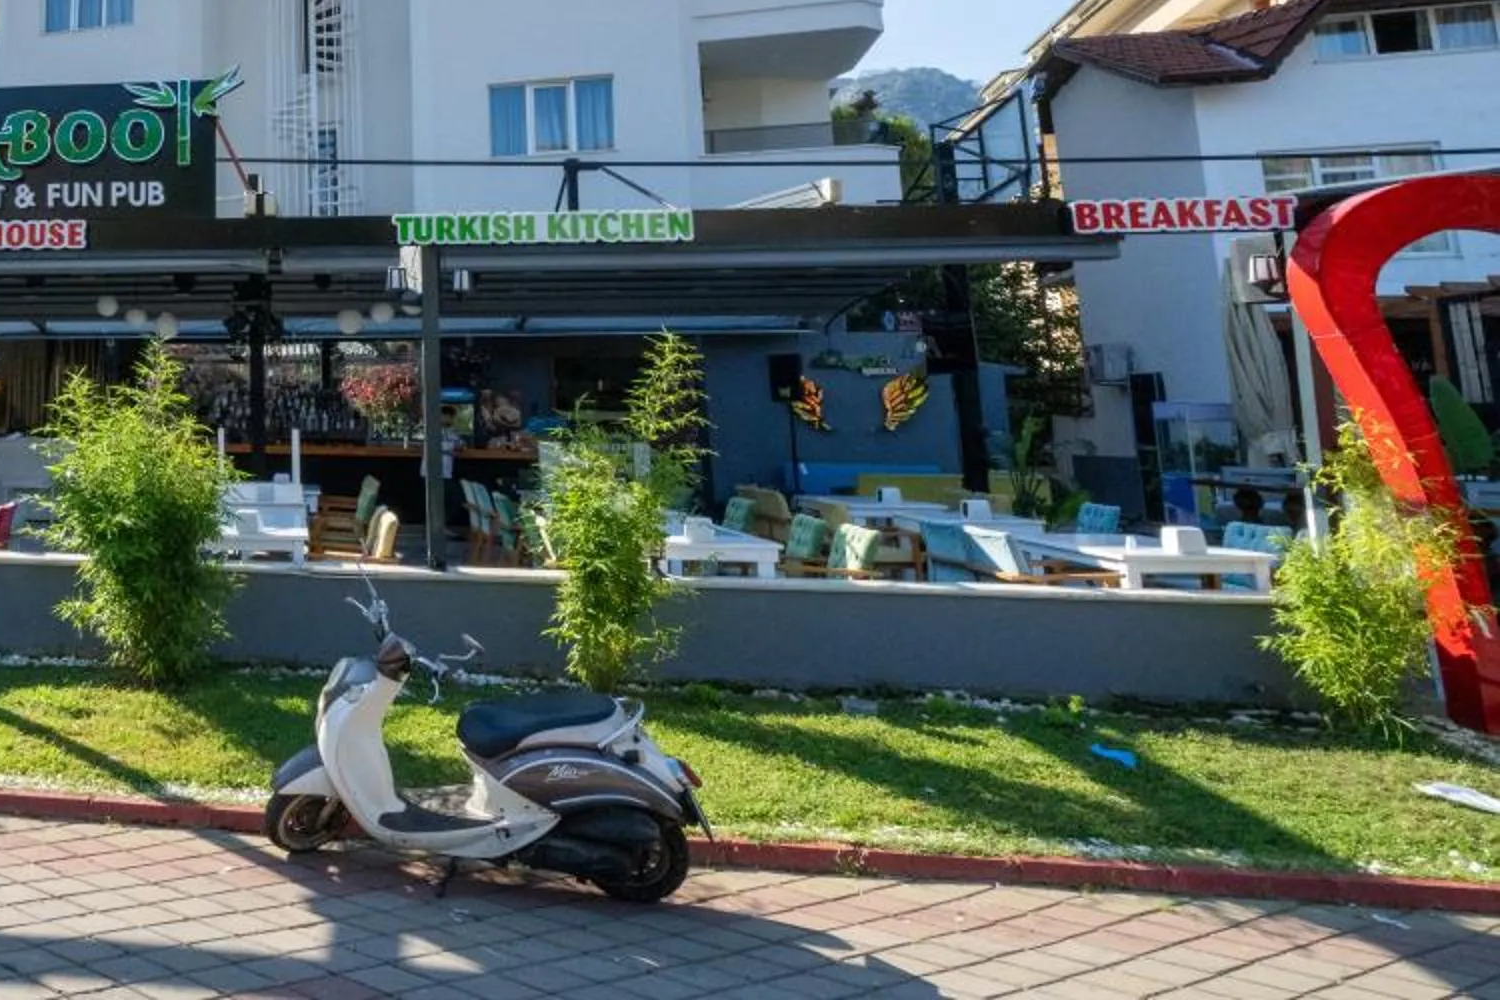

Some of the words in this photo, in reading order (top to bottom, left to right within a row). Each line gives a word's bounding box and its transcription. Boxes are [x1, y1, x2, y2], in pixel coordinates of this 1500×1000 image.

[13, 183, 37, 209] &
[46, 181, 104, 208] FUN
[110, 180, 166, 206] PUB
[395, 214, 536, 242] TURKISH
[546, 210, 692, 241] KITCHEN
[1073, 198, 1295, 230] BREAKFAST
